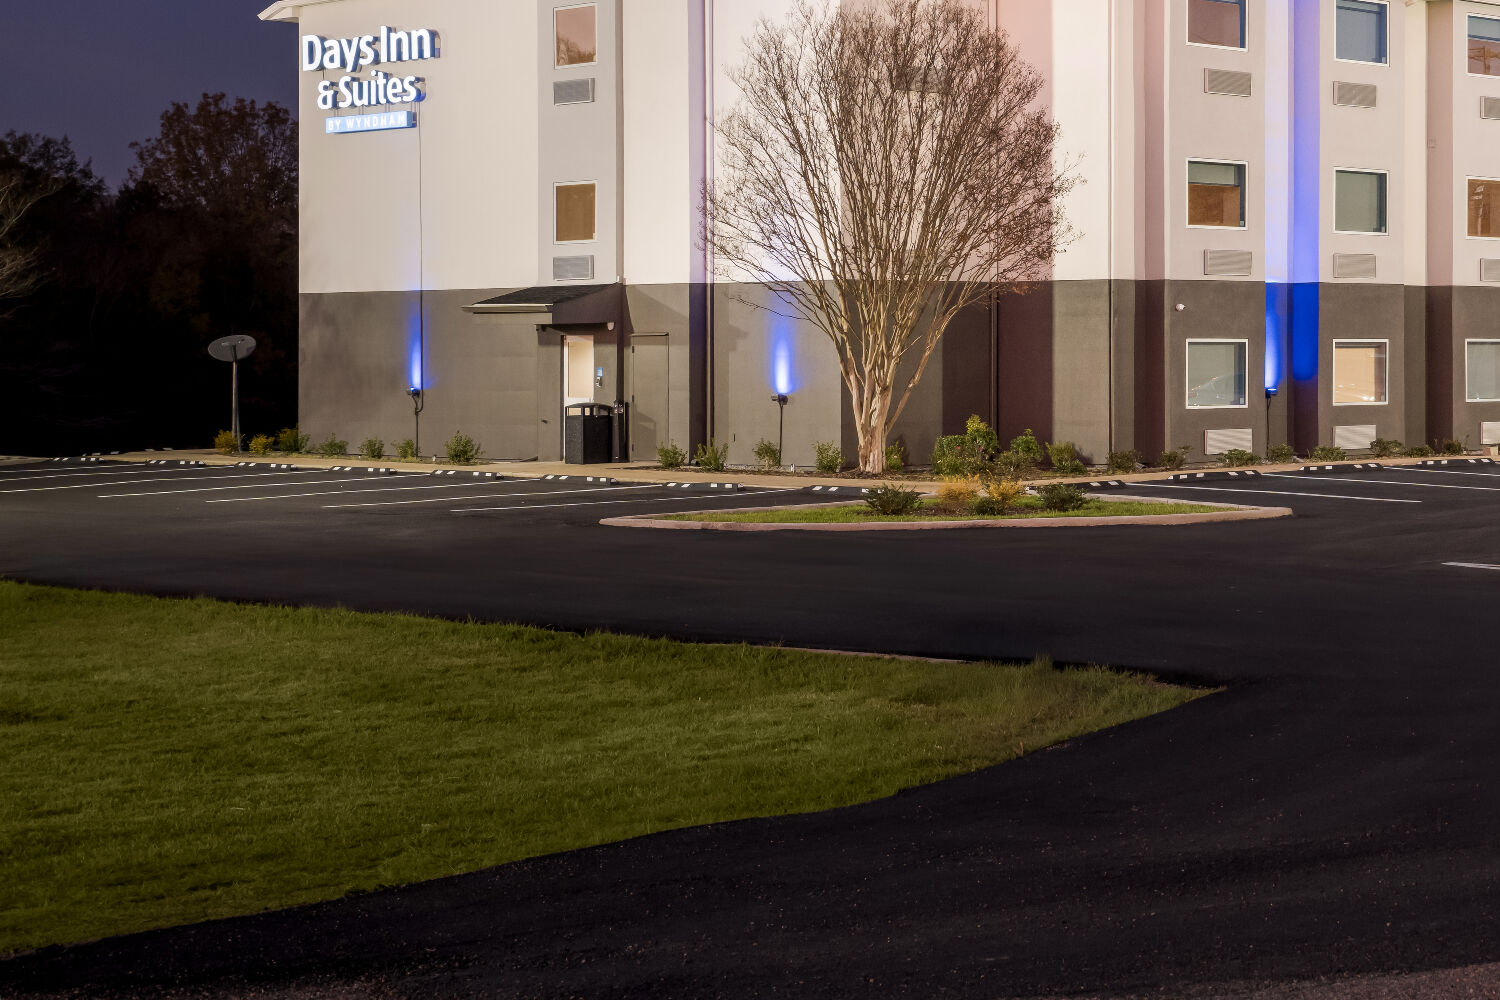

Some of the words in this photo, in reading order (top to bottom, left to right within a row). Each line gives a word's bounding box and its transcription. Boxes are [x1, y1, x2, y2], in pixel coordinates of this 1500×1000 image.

[302, 34, 377, 73] Days
[380, 25, 434, 63] Inn
[317, 80, 334, 110] &
[338, 69, 418, 108] Suites
[328, 118, 341, 131] BY
[345, 112, 406, 130] WYNDHAM
